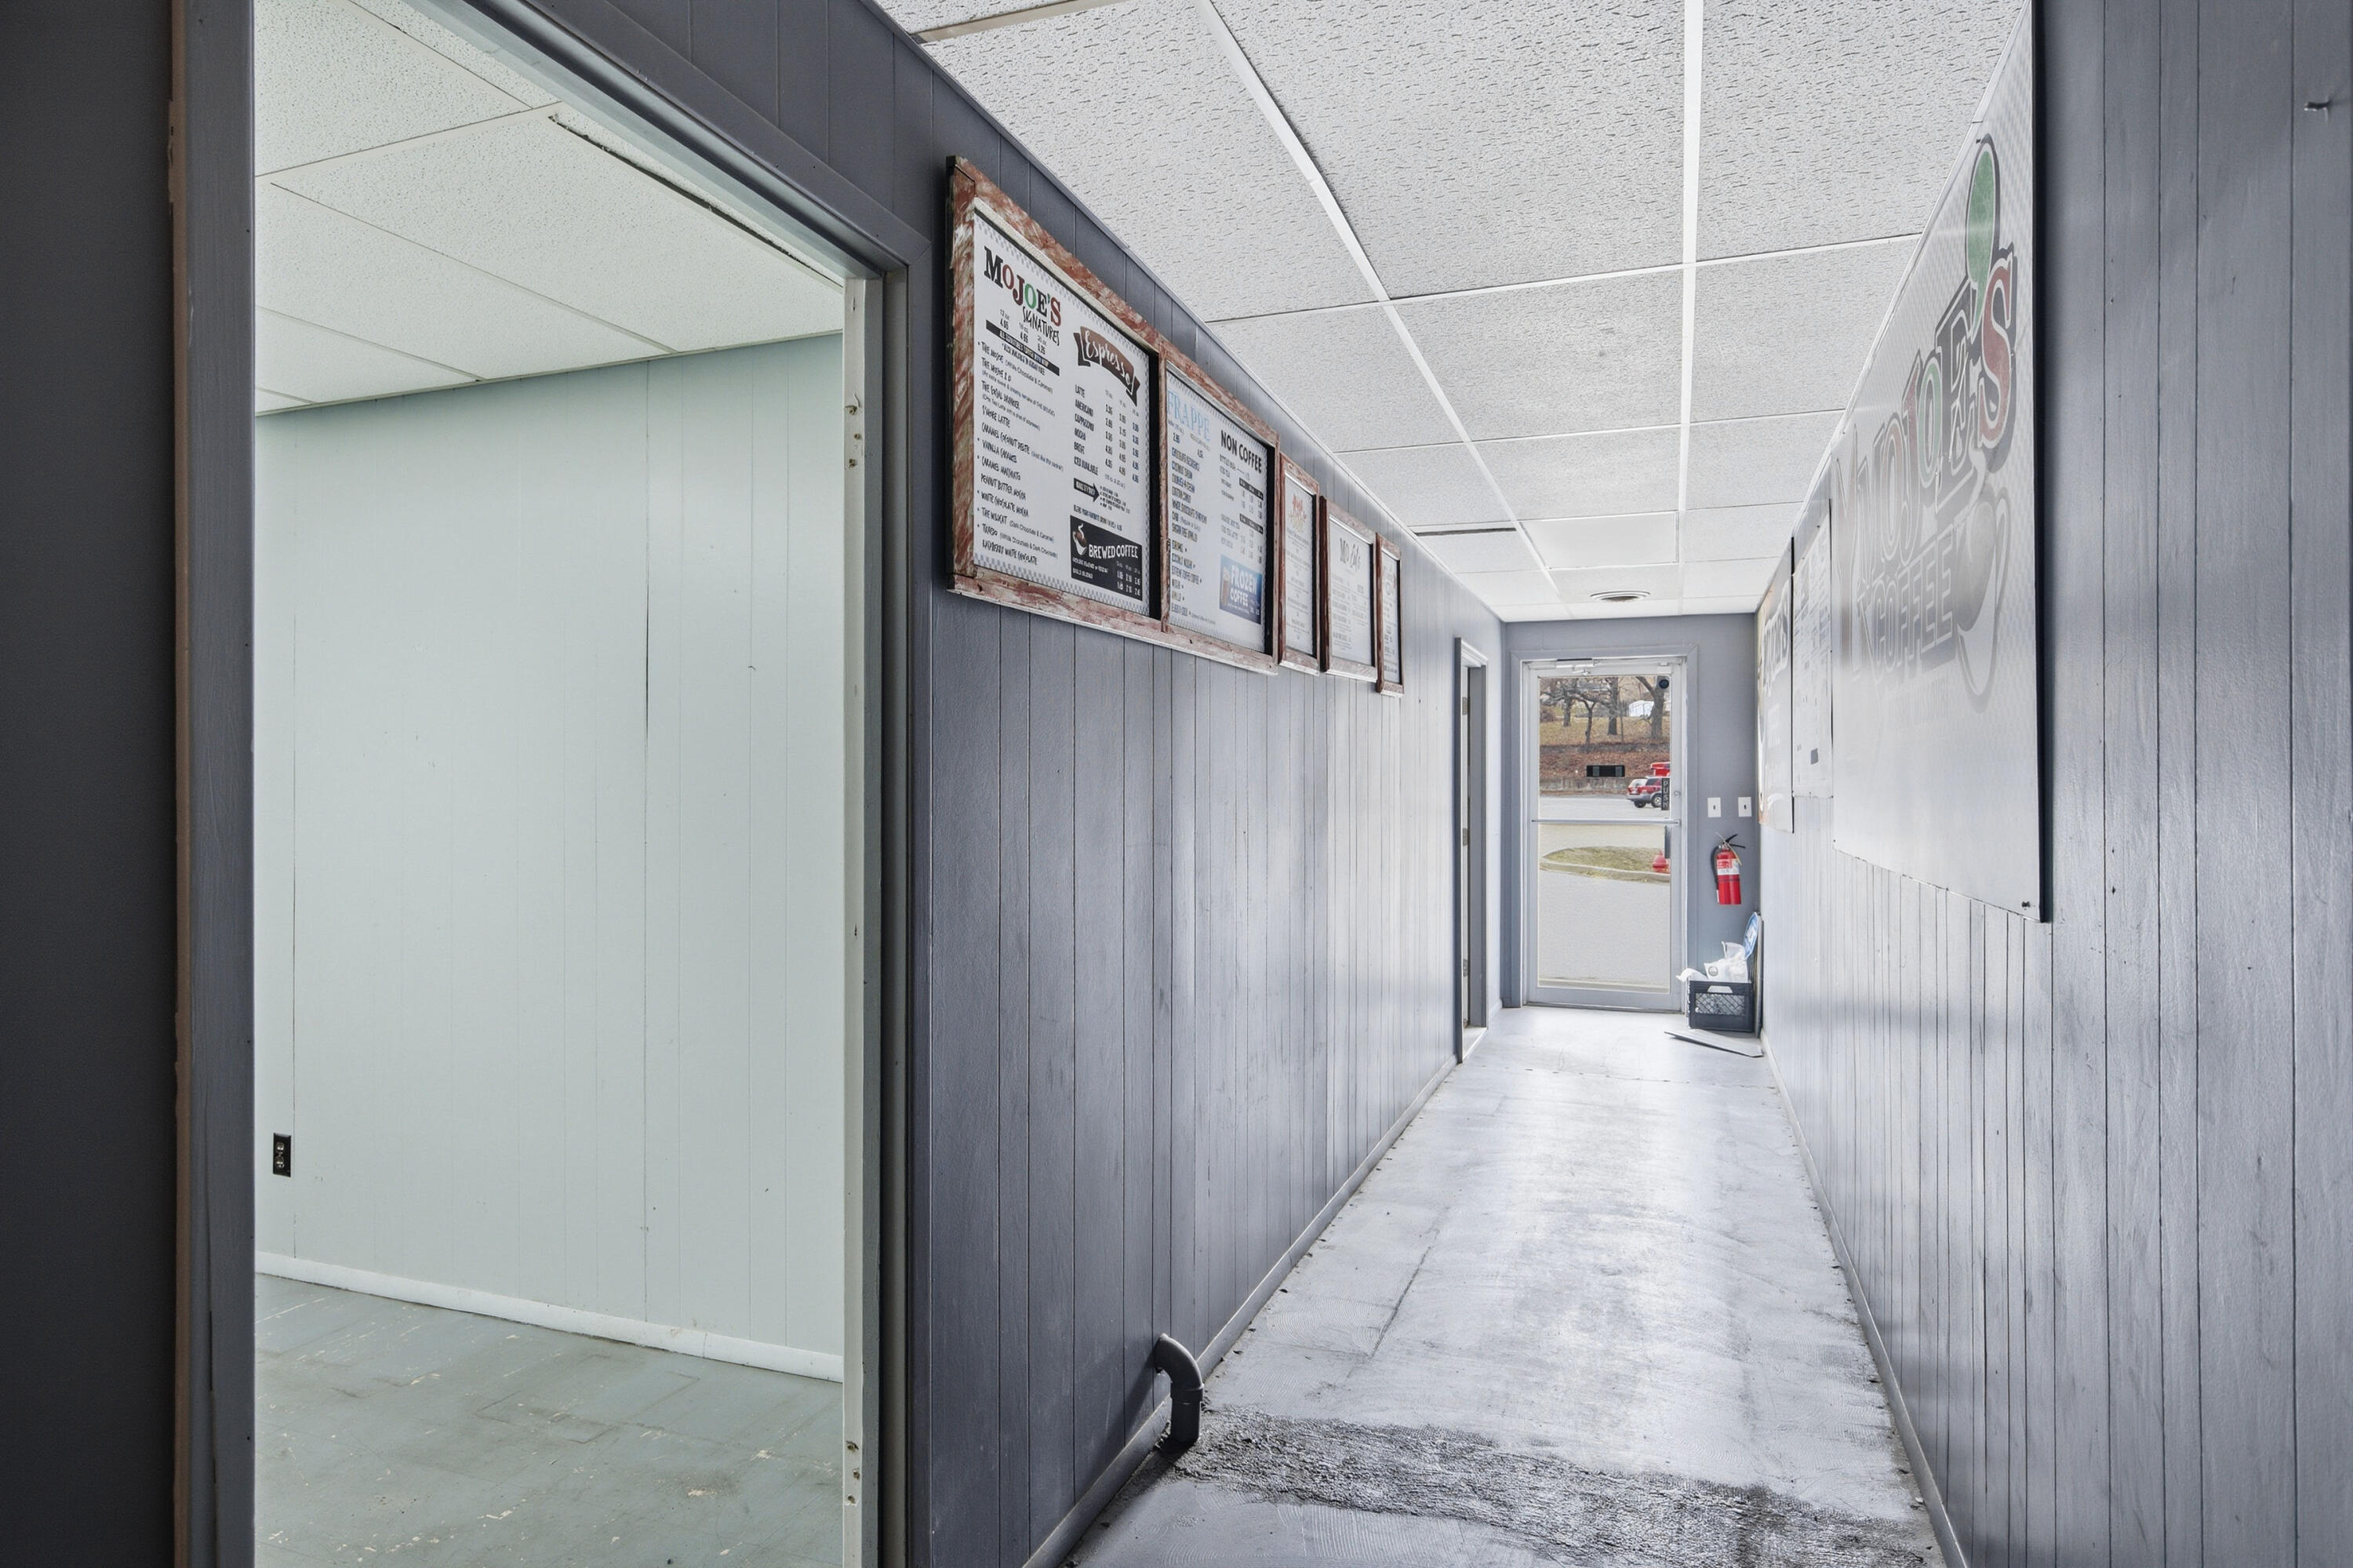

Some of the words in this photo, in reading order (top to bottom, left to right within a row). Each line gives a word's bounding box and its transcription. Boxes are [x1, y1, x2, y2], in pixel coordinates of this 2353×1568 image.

[984, 245, 1062, 327] MOJOE'S
[1022, 306, 1060, 346] SIGNATURES
[1085, 329, 1130, 386] Espresso
[1854, 133, 2016, 588] MOJOE'S
[1075, 384, 1085, 398] LATTE
[998, 413, 1009, 427] LATTE
[1167, 391, 1210, 442] FRAPPE
[982, 439, 998, 456] VANILLA
[1220, 430, 1237, 457] NON
[1238, 444, 1262, 474] COFFEE
[981, 490, 993, 504] WHITE
[994, 496, 1014, 512] CHOCOLATE
[1017, 551, 1037, 566] CHOCOLATE
[1088, 544, 1115, 559] BREWED
[1115, 544, 1139, 558] COFFEE
[1230, 564, 1258, 596] FROZEN
[1229, 587, 1249, 607] COFFEE
[1870, 537, 1955, 684] COFFEE
